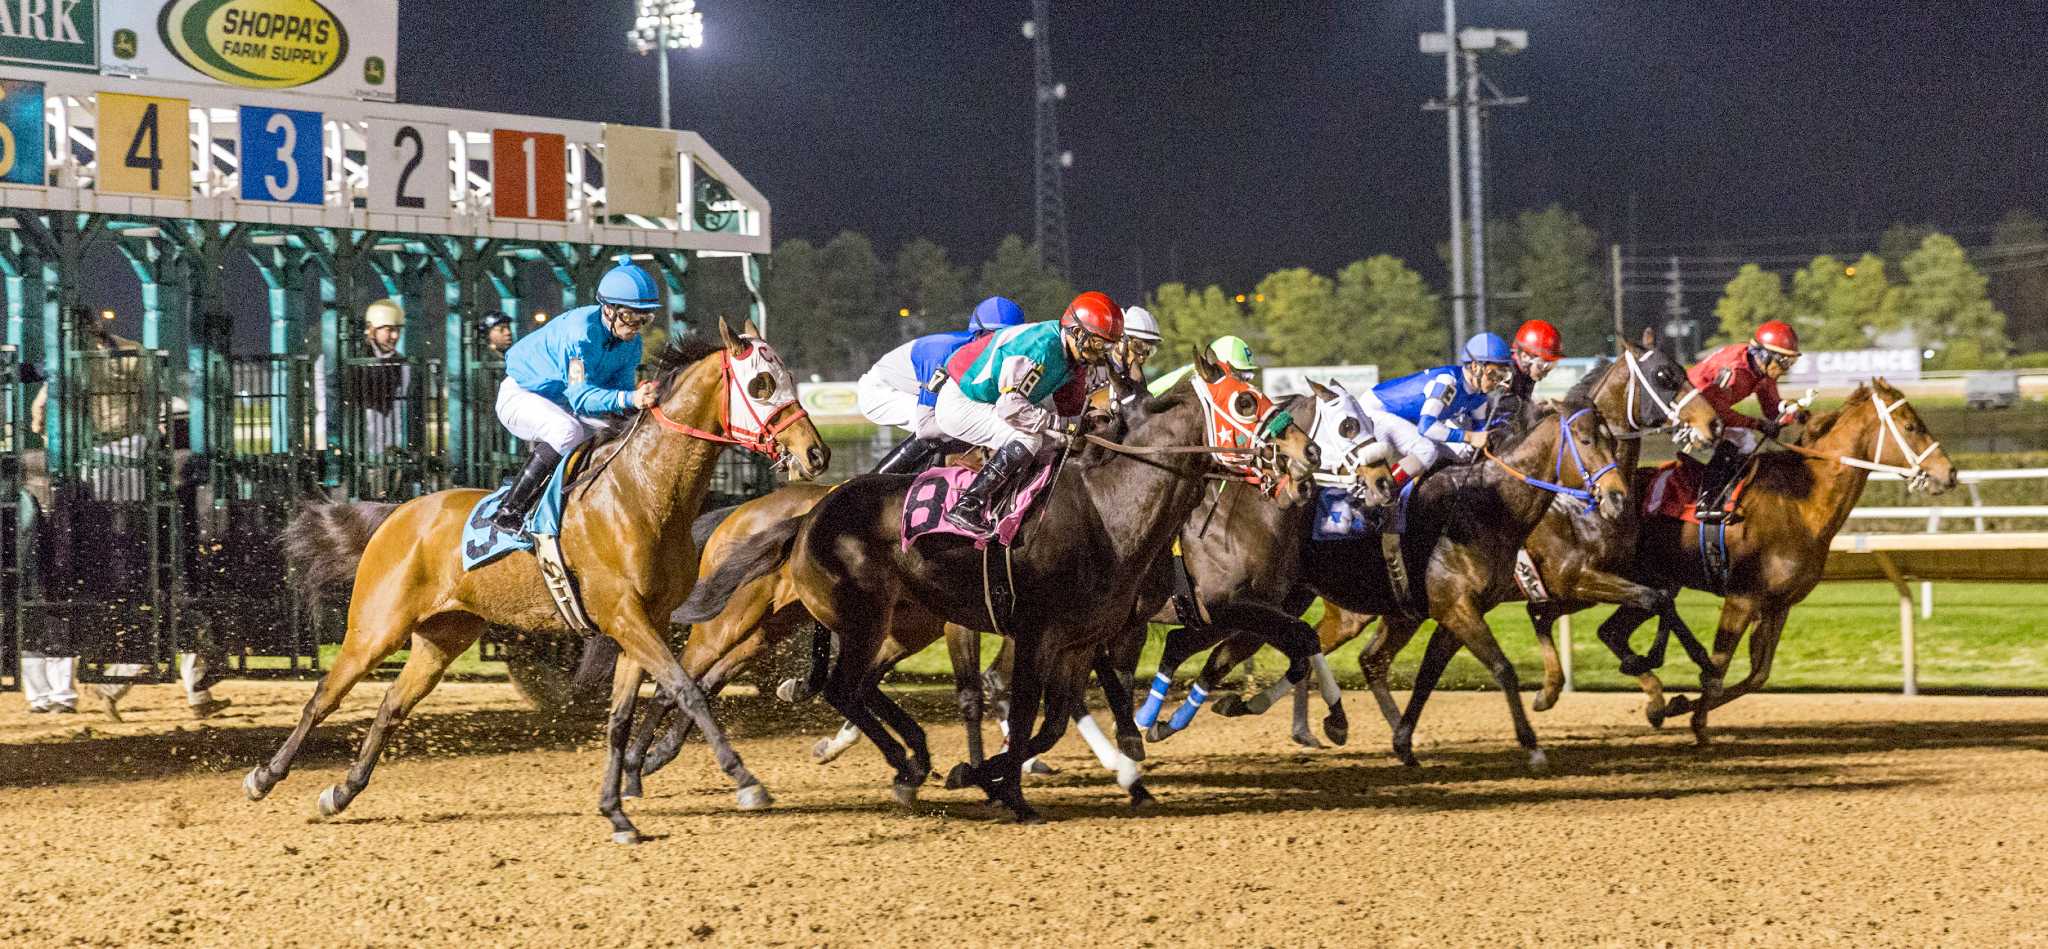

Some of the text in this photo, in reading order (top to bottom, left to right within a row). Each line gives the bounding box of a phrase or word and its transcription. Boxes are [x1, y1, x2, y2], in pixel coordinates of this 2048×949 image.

[223, 8, 331, 45] SHOPPA'S
[222, 41, 328, 65] FARM SUPPLY
[124, 103, 162, 191] 4
[264, 113, 300, 201] 3
[394, 126, 425, 209] 2
[522, 138, 537, 217] 1
[927, 369, 946, 392] 7
[1020, 370, 1041, 398] 8
[1817, 350, 1915, 373] CADENCE
[904, 476, 950, 541] 8
